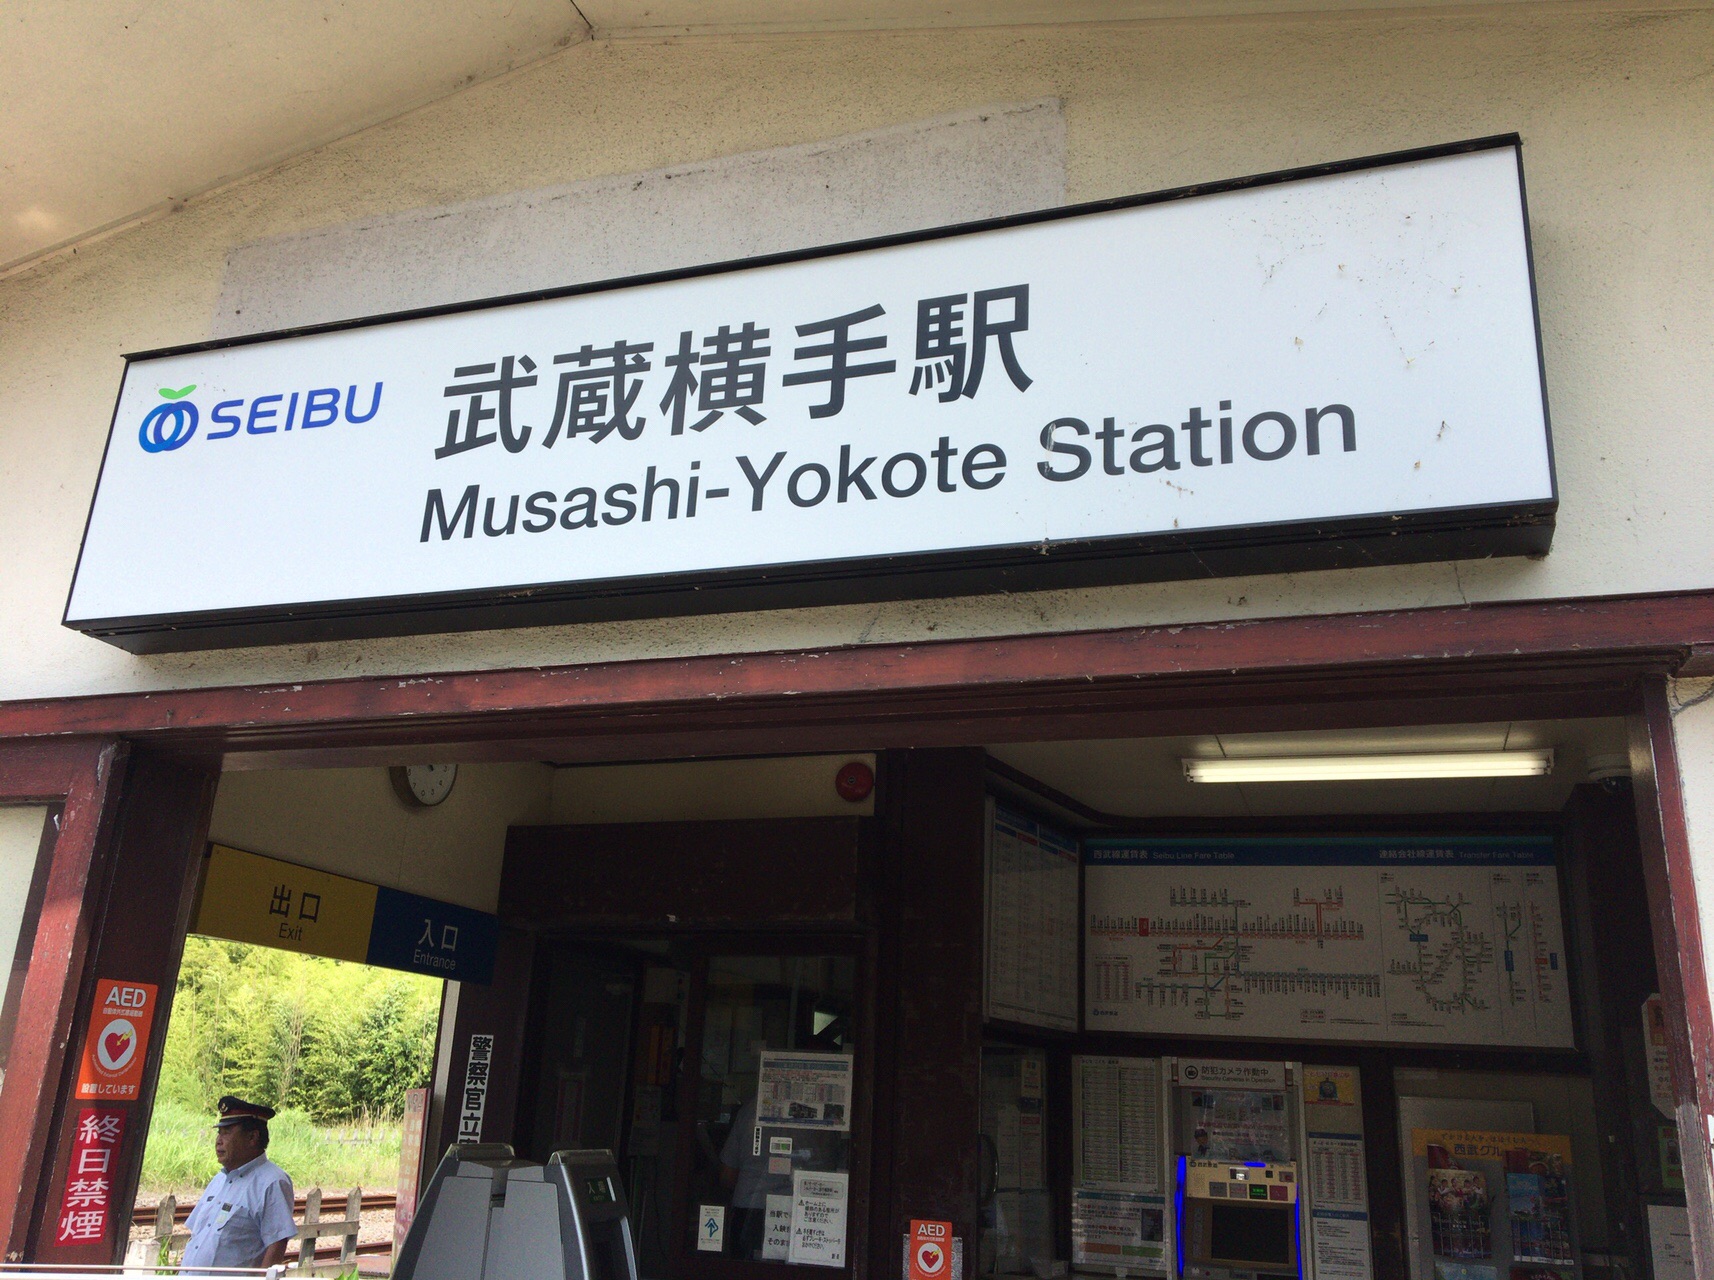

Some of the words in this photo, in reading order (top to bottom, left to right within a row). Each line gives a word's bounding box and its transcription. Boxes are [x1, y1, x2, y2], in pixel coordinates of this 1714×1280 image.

[434, 283, 1034, 459] 武蔵横手駅
[207, 382, 383, 440] SEIBU
[419, 436, 1007, 542] Musashi-Yokote
[1037, 402, 1356, 481] Station
[268, 884, 321, 924] 出口
[279, 923, 303, 942] Exit
[418, 918, 458, 952] 入口
[413, 948, 456, 971] Entrance
[105, 986, 146, 1008] AED
[1201, 1066, 1269, 1076] 防犯カメラ作動中
[81, 1082, 136, 1095] 設置しています
[61, 1114, 120, 1242] 終日禁煙
[917, 1223, 946, 1236] AED
